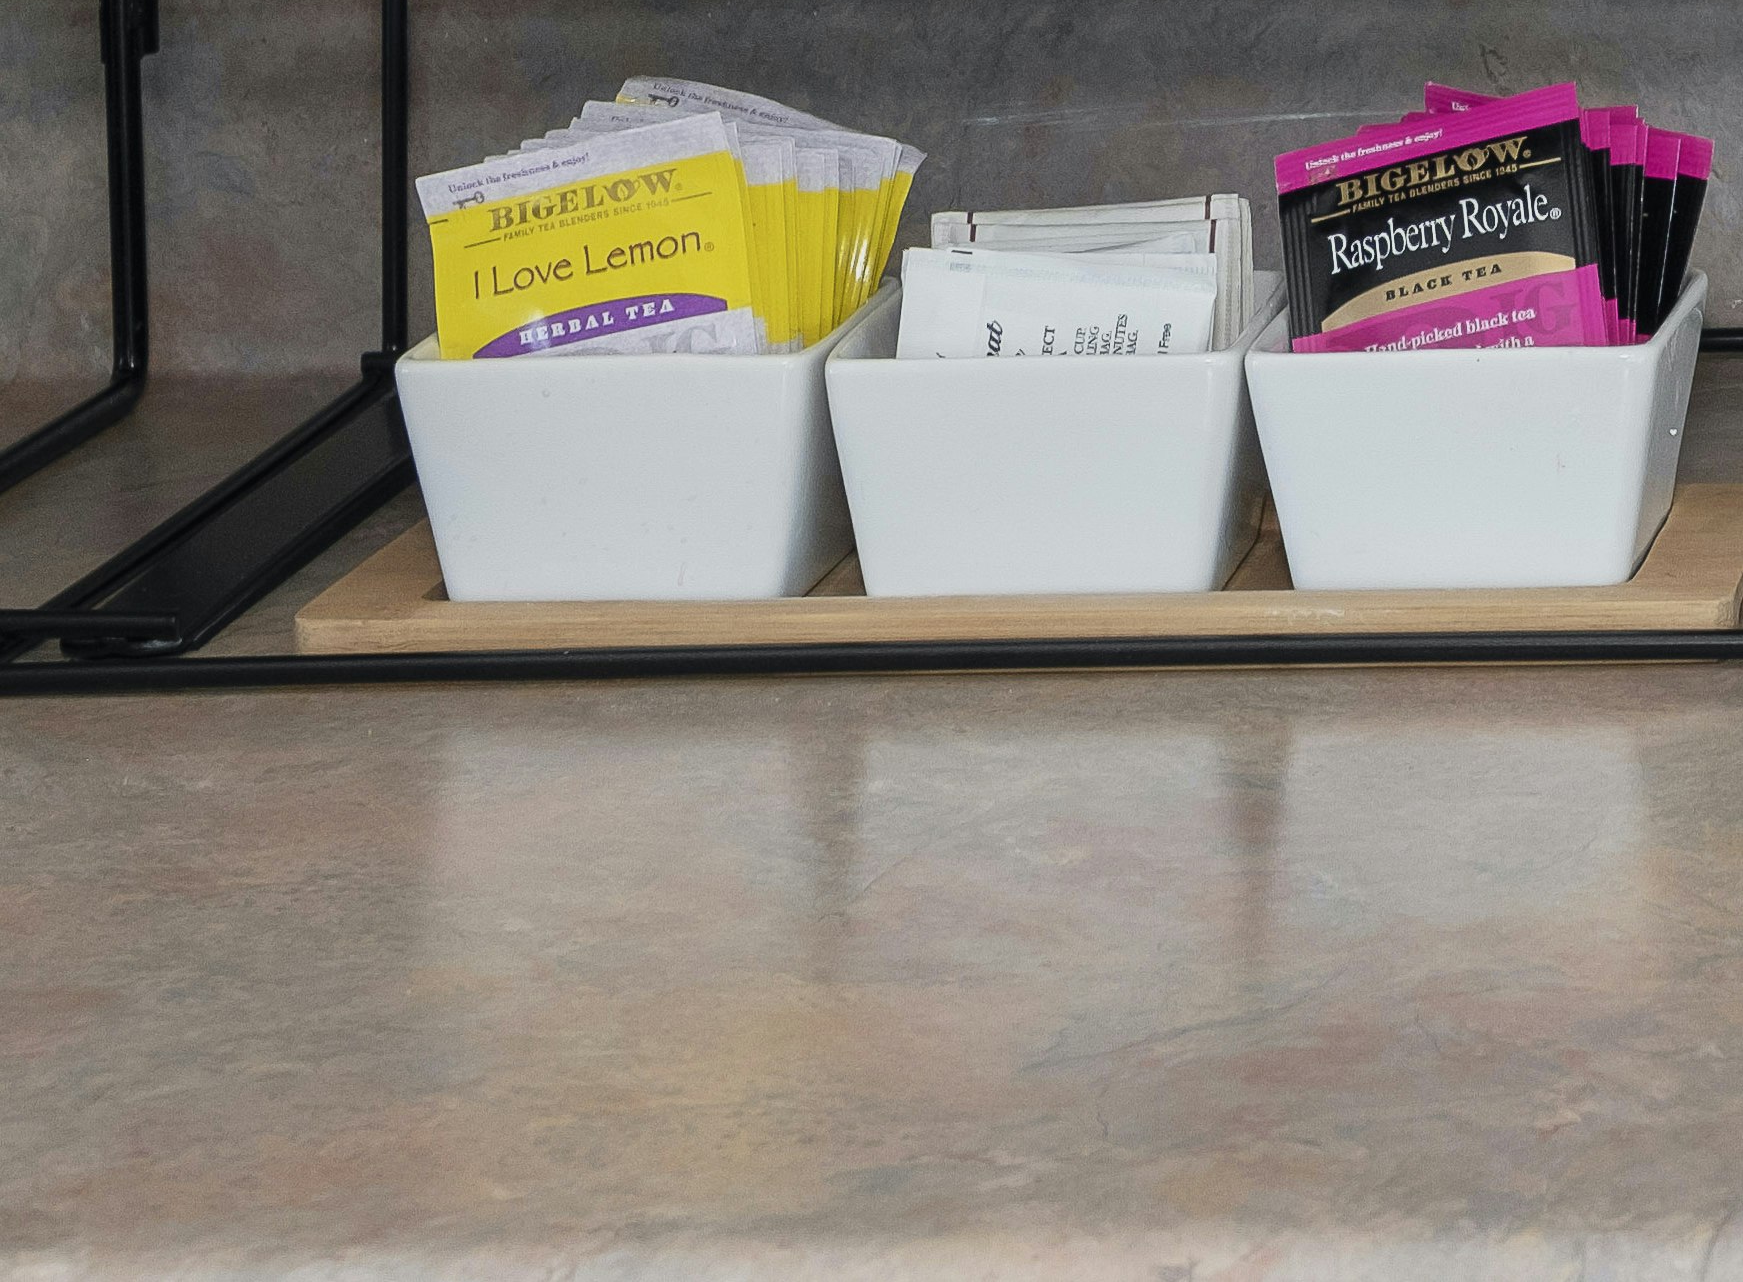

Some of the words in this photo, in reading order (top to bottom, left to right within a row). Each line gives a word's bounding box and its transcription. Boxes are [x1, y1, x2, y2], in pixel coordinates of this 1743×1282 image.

[1336, 136, 1528, 206] BIGELOW
[1352, 196, 1385, 213] FAMILY
[1388, 191, 1407, 203] TEA
[1409, 179, 1460, 198] BLENDERS
[1463, 169, 1492, 183] SINCE
[487, 168, 677, 232] BIGELOW
[503, 226, 534, 242] FAMILY
[538, 221, 556, 232] TEA
[559, 211, 610, 228] BLENDERS
[613, 204, 643, 215] SINCE
[1328, 214, 1456, 275] Raspberry
[1459, 184, 1549, 240] Royale
[473, 270, 480, 299] I
[493, 259, 573, 296] Love
[583, 231, 702, 276] Lemon
[1385, 273, 1453, 302] BLACK
[1462, 262, 1502, 282] TEA
[519, 311, 615, 345] HERBAL
[625, 298, 676, 320] TEA
[1466, 312, 1509, 335] black
[1511, 307, 1536, 323] tea
